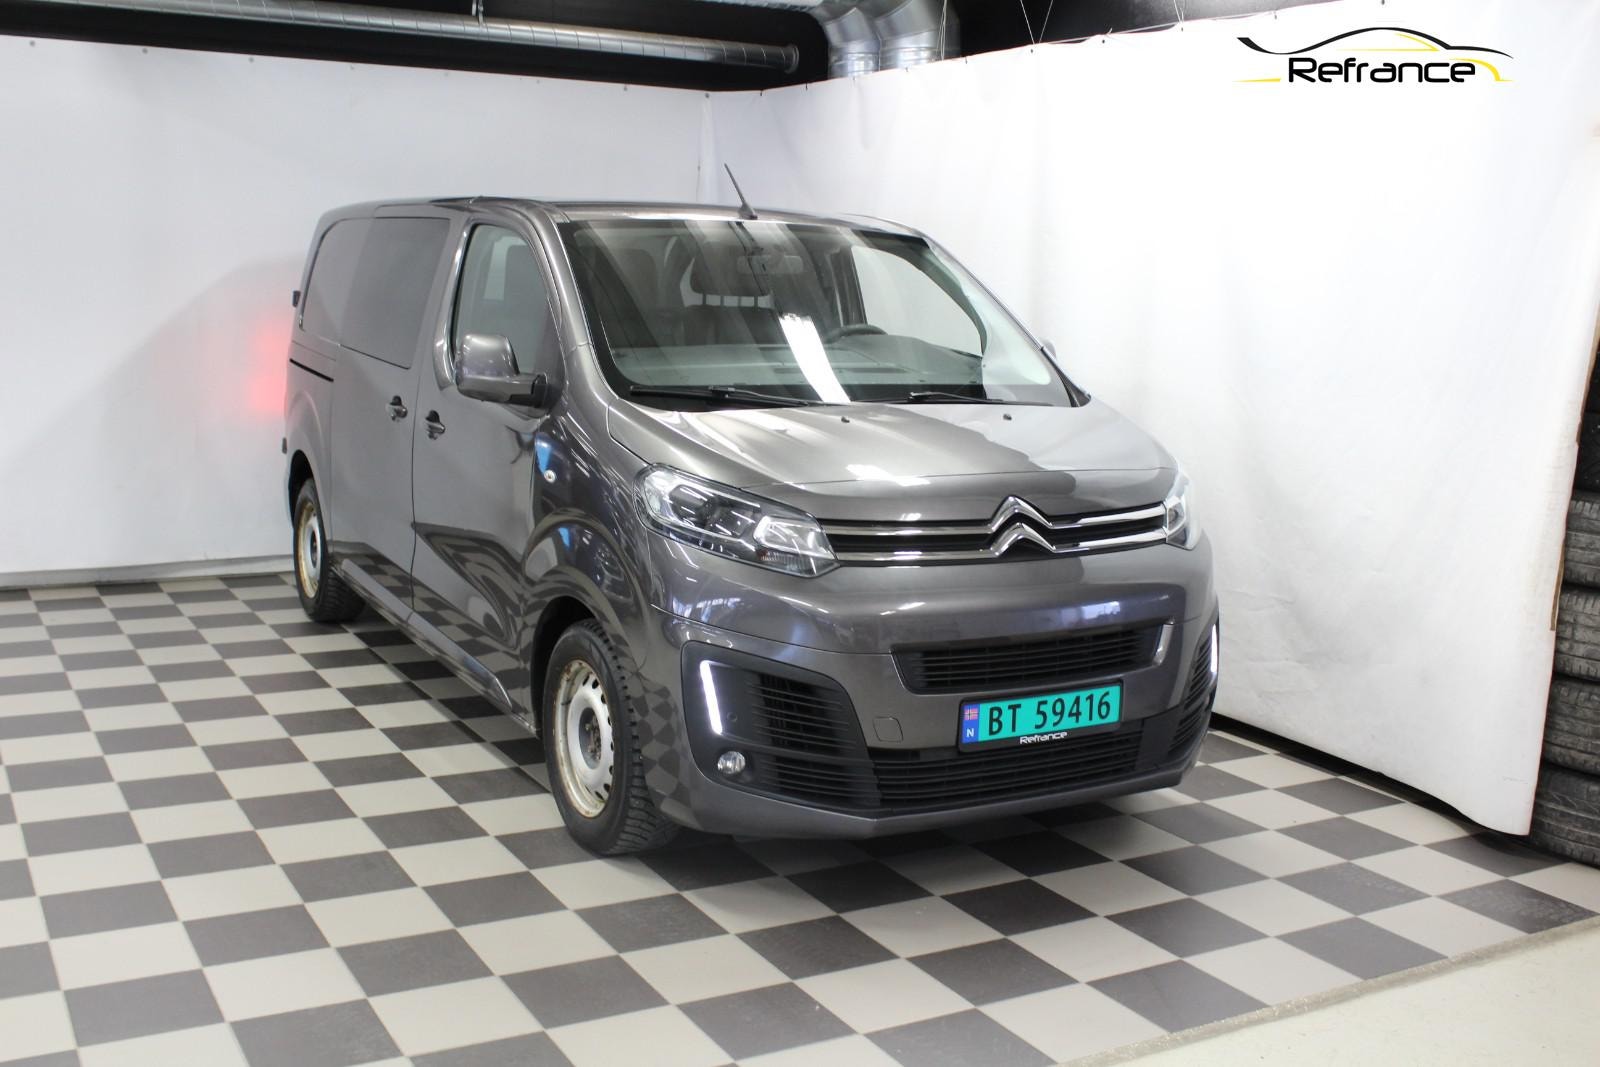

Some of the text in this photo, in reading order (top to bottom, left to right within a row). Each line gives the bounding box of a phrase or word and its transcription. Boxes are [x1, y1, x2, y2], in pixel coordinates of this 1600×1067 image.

[988, 691, 1111, 736] BT 59416
[966, 728, 975, 738] N
[1019, 731, 1068, 745] Refrance
